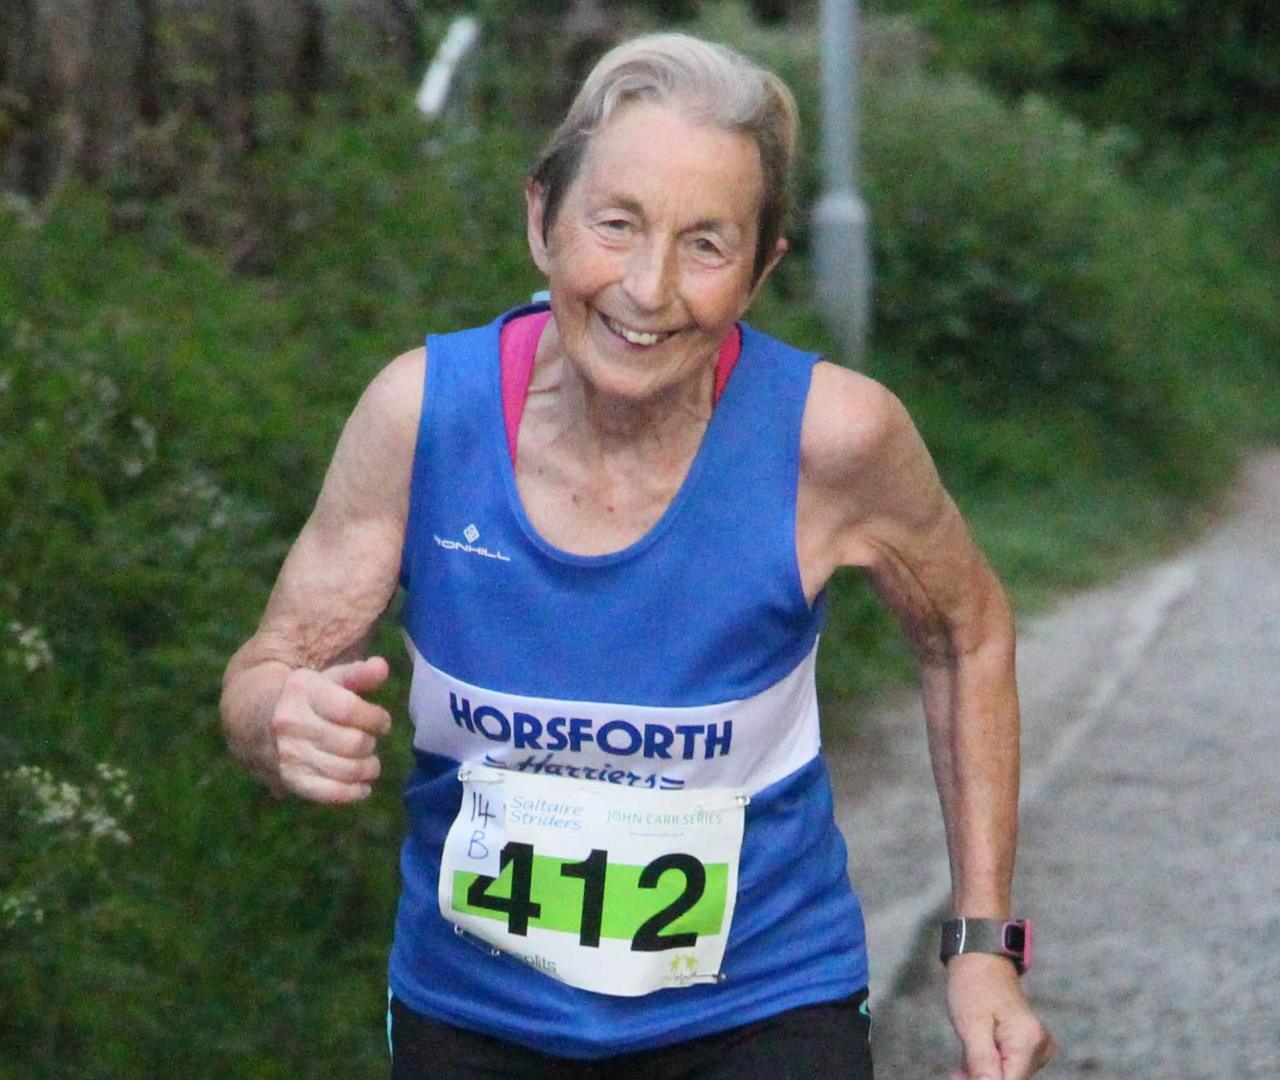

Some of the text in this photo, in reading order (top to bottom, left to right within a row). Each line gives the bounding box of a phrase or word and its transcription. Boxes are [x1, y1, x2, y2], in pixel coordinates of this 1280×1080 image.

[449, 692, 732, 760] HORSFORTH
[516, 753, 655, 789] Harriers
[470, 791, 496, 828] 14
[509, 810, 583, 831] Striders
[511, 796, 584, 817] Saltaire
[608, 810, 723, 825] JOHN CARR SERIES
[467, 841, 706, 951] 412
